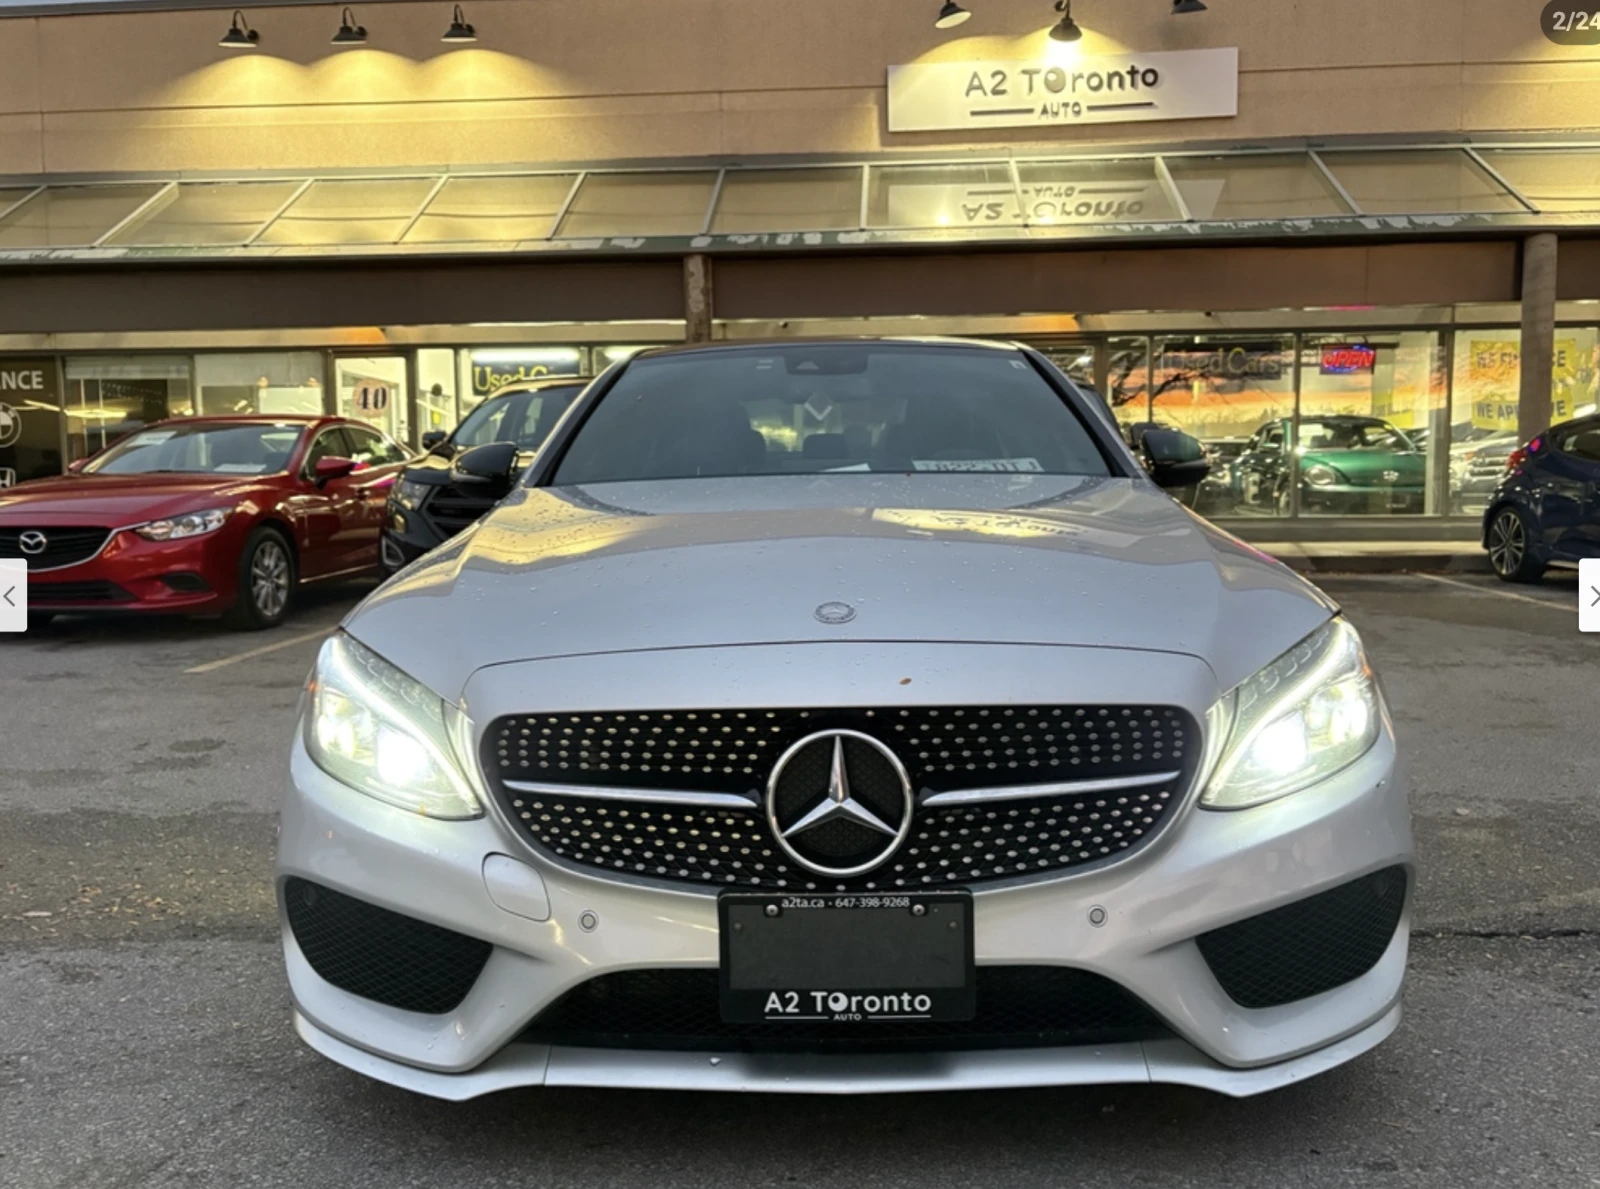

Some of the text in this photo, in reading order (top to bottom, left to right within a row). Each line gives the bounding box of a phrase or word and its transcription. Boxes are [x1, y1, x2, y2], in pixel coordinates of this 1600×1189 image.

[965, 70, 1008, 97] A2
[1039, 101, 1082, 118] AUTO
[1323, 350, 1374, 368] OPEN
[0, 370, 43, 389] NCE
[357, 386, 387, 409] 40
[781, 897, 910, 908] a2ta.ca 647-398-9268
[764, 991, 800, 1013] A2
[833, 1013, 862, 1021] AUTO
